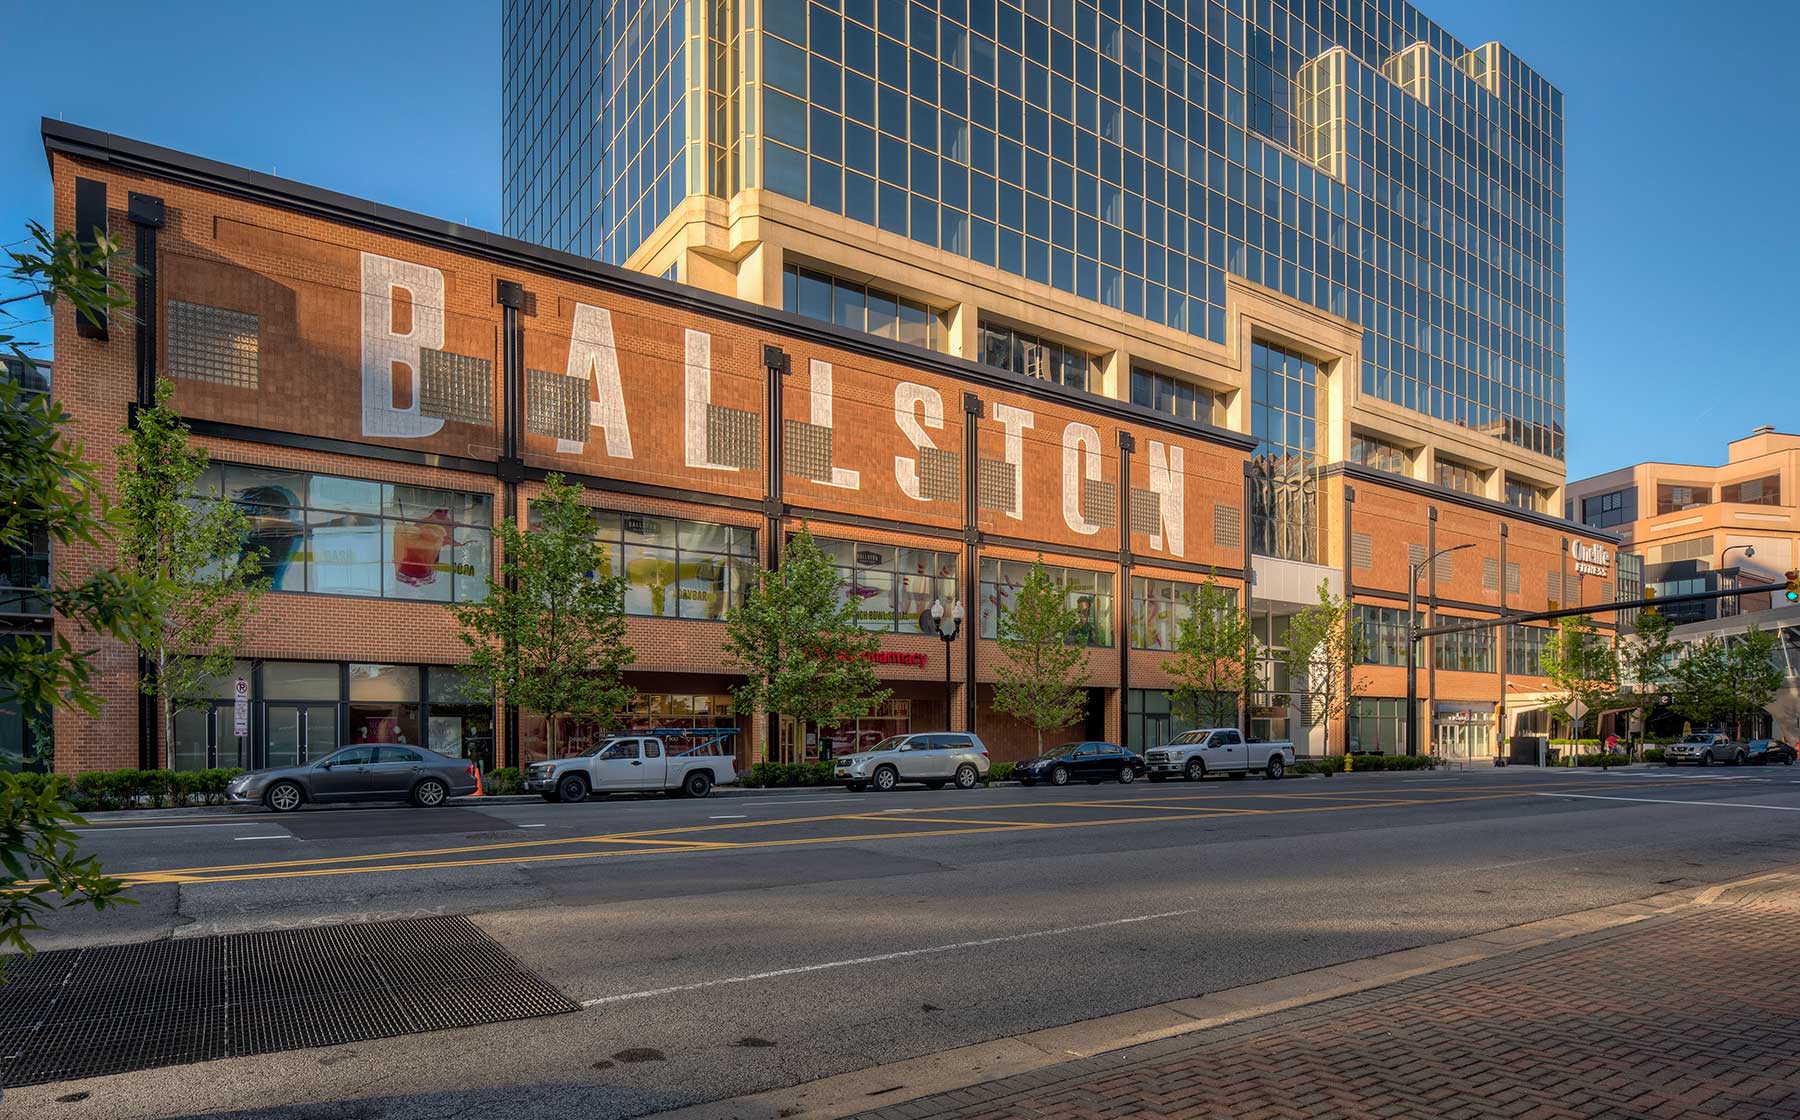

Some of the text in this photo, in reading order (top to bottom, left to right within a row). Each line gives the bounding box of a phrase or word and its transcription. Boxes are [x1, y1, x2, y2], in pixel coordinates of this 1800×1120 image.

[360, 251, 1185, 557] BALLSTON
[1572, 539, 1610, 566] Onelife
[1575, 562, 1608, 577] FITNESS
[888, 611, 907, 621] SOIAL
